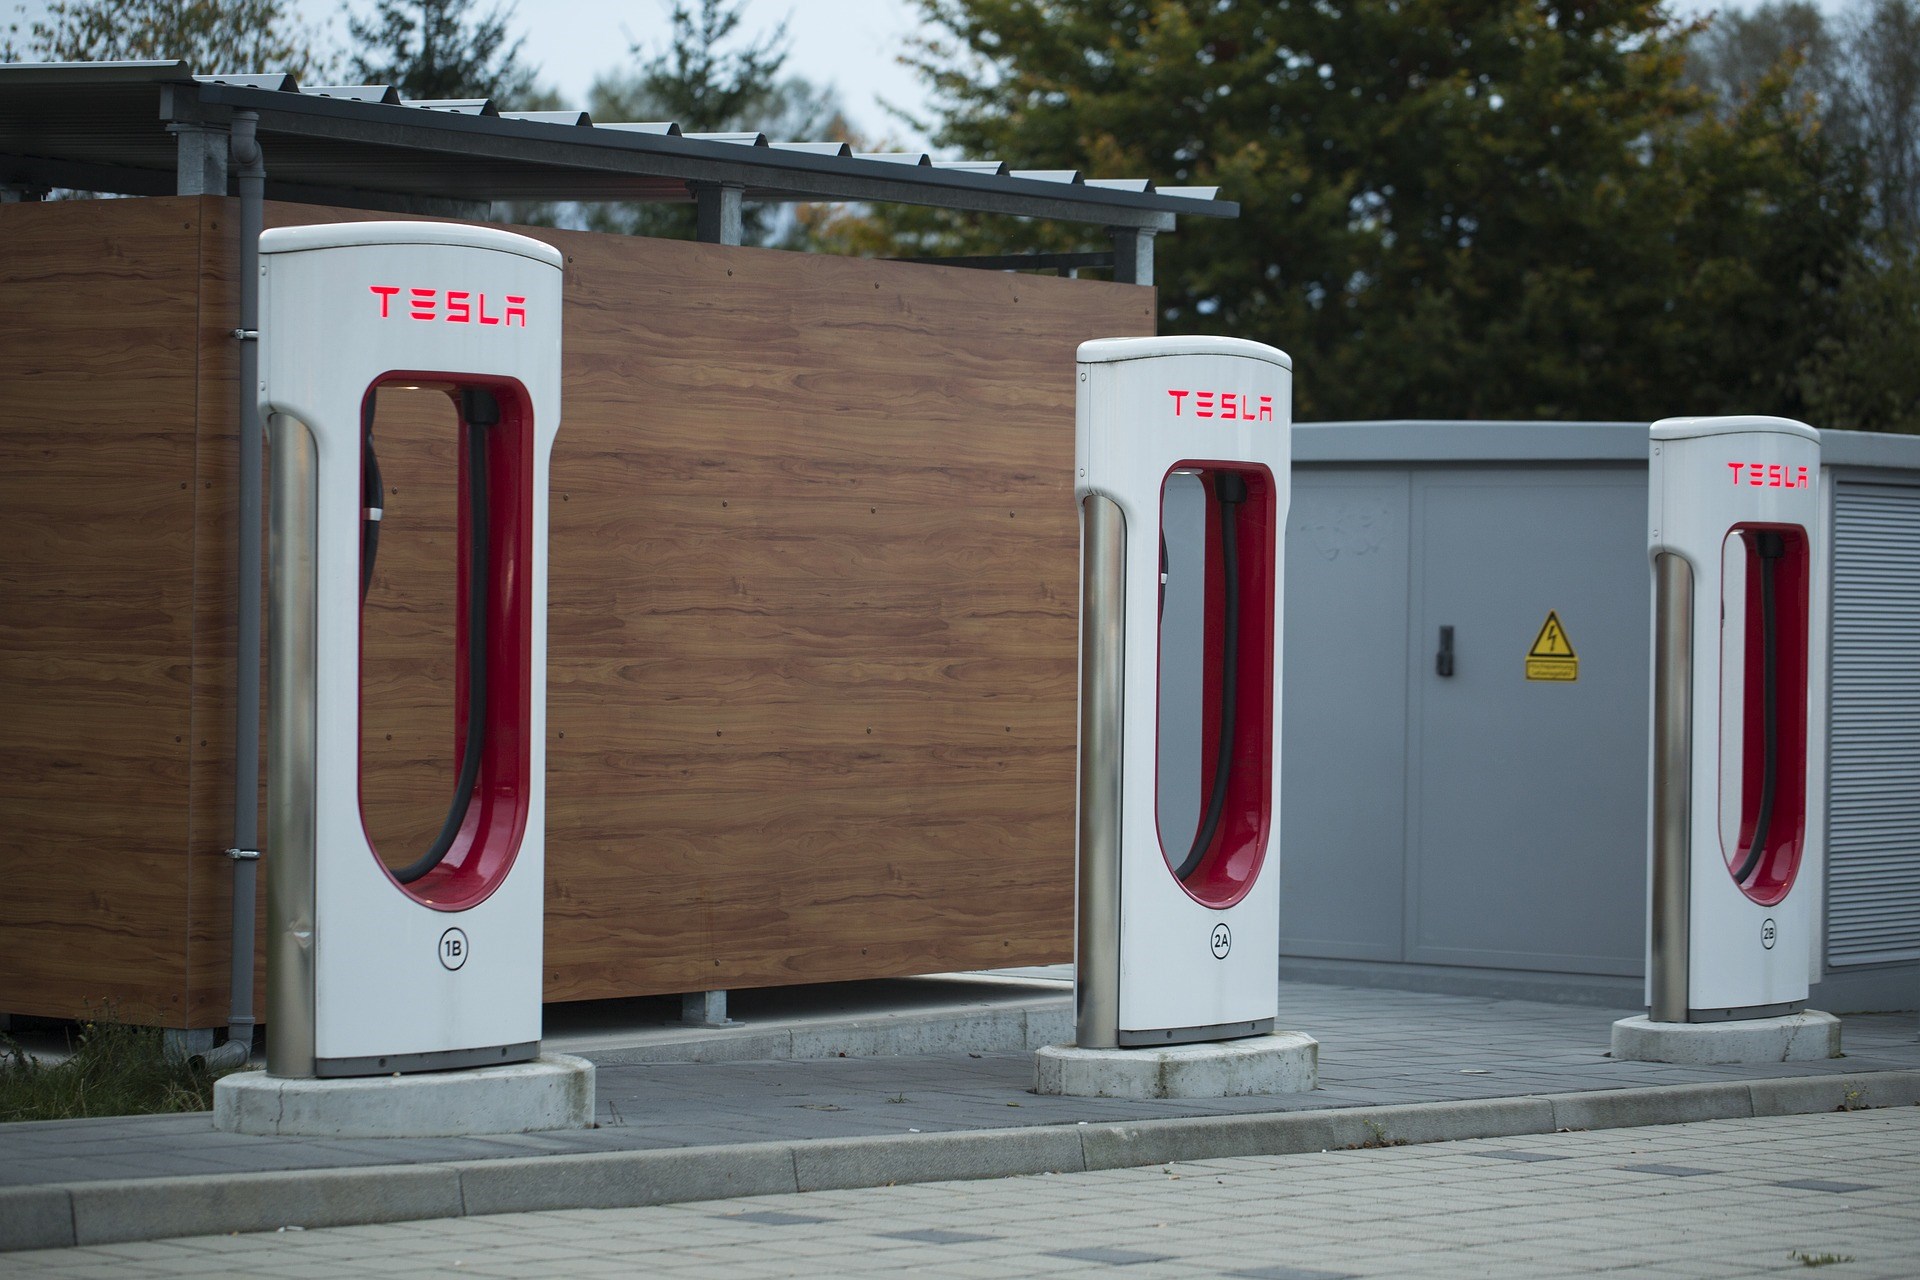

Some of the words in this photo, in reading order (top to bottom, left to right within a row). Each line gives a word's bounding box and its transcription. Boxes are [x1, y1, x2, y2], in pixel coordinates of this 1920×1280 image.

[369, 286, 526, 327] TESLA
[1168, 390, 1272, 420] TESLA
[1728, 462, 1808, 488] TESLA
[1214, 933, 1229, 948] 2A
[1763, 927, 1775, 940] 2B
[445, 940, 462, 957] 1B
